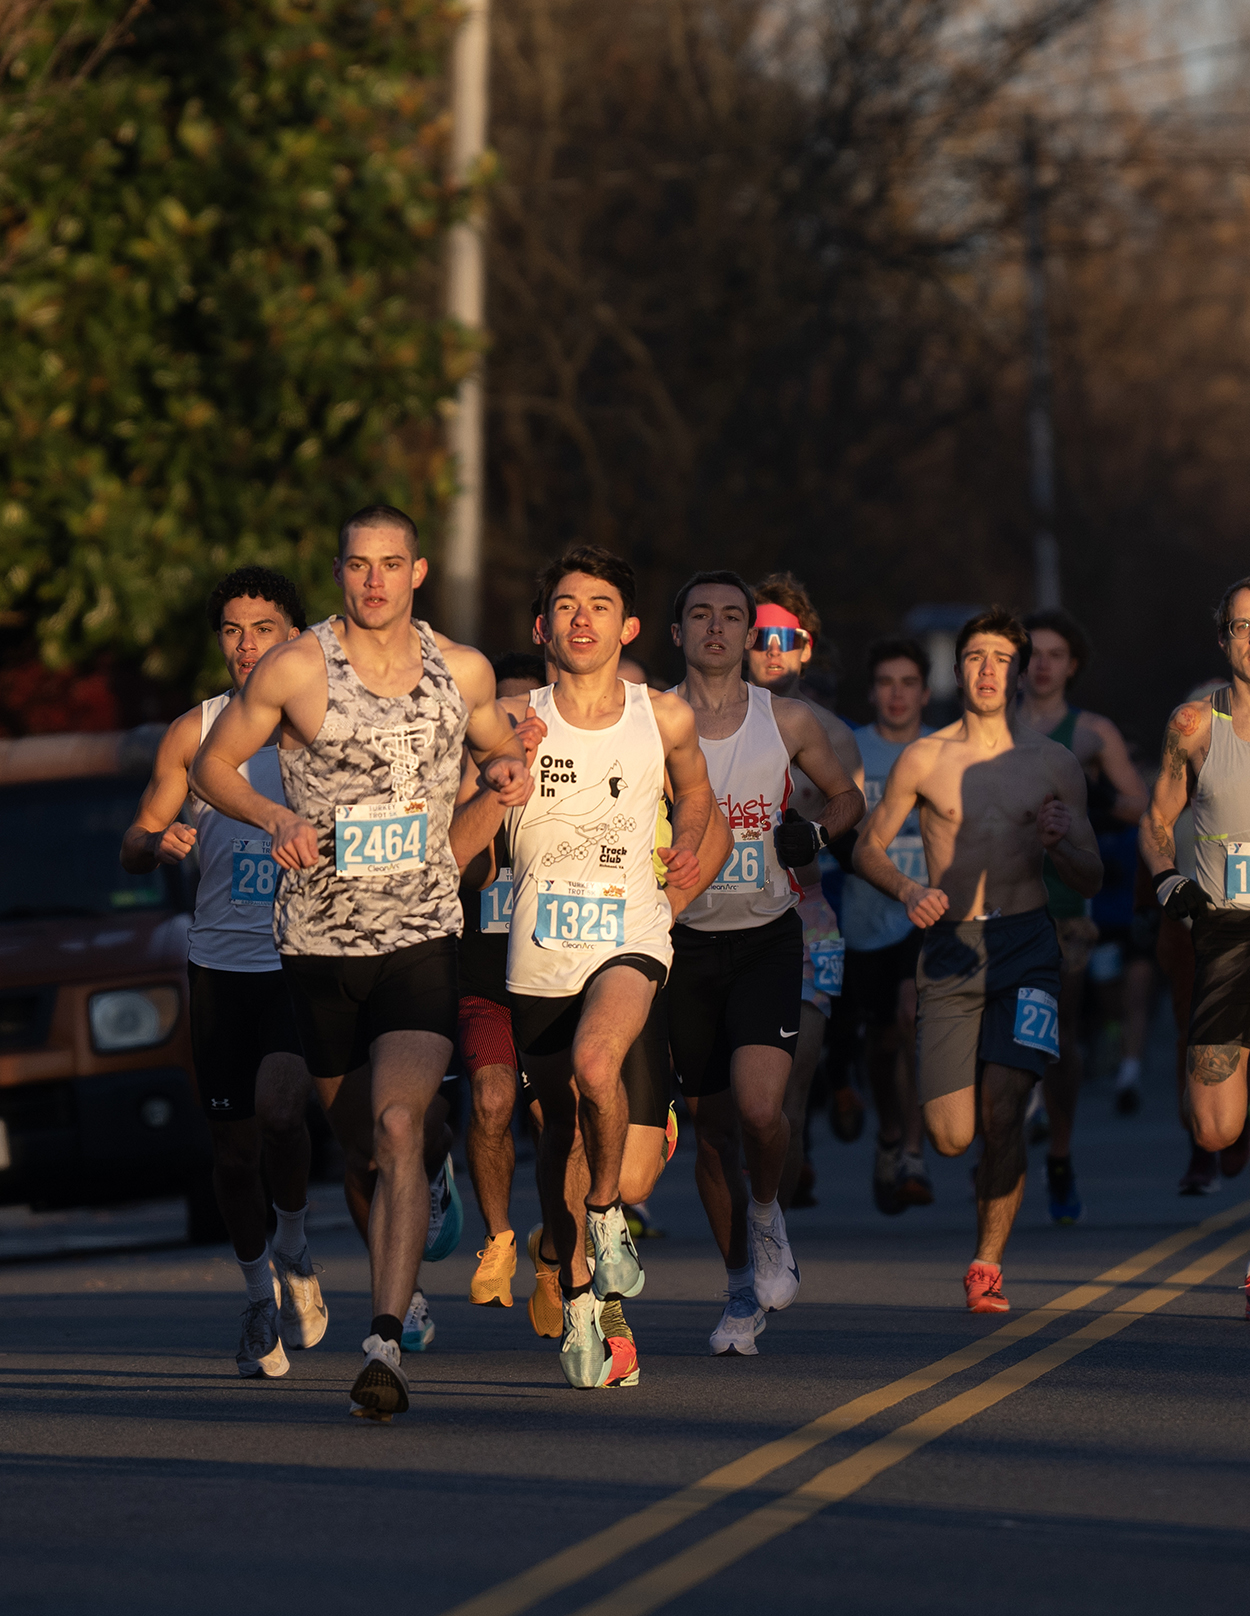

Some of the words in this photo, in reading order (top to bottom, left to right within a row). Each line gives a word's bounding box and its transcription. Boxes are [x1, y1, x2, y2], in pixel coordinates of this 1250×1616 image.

[540, 755, 574, 768] One
[540, 770, 577, 783] Foot
[540, 784, 556, 797] In
[368, 804, 396, 812] TURKEY
[727, 814, 771, 831] ERS
[343, 820, 421, 863] 2464
[600, 845, 627, 855] Track
[599, 854, 622, 864] Club
[715, 847, 758, 881] 26
[367, 863, 400, 873] CleanArc
[238, 858, 281, 894] 28
[568, 881, 595, 889] TURKEY
[546, 900, 618, 941] 1325
[561, 940, 595, 949] CleanArc
[1020, 1004, 1059, 1045] 274
